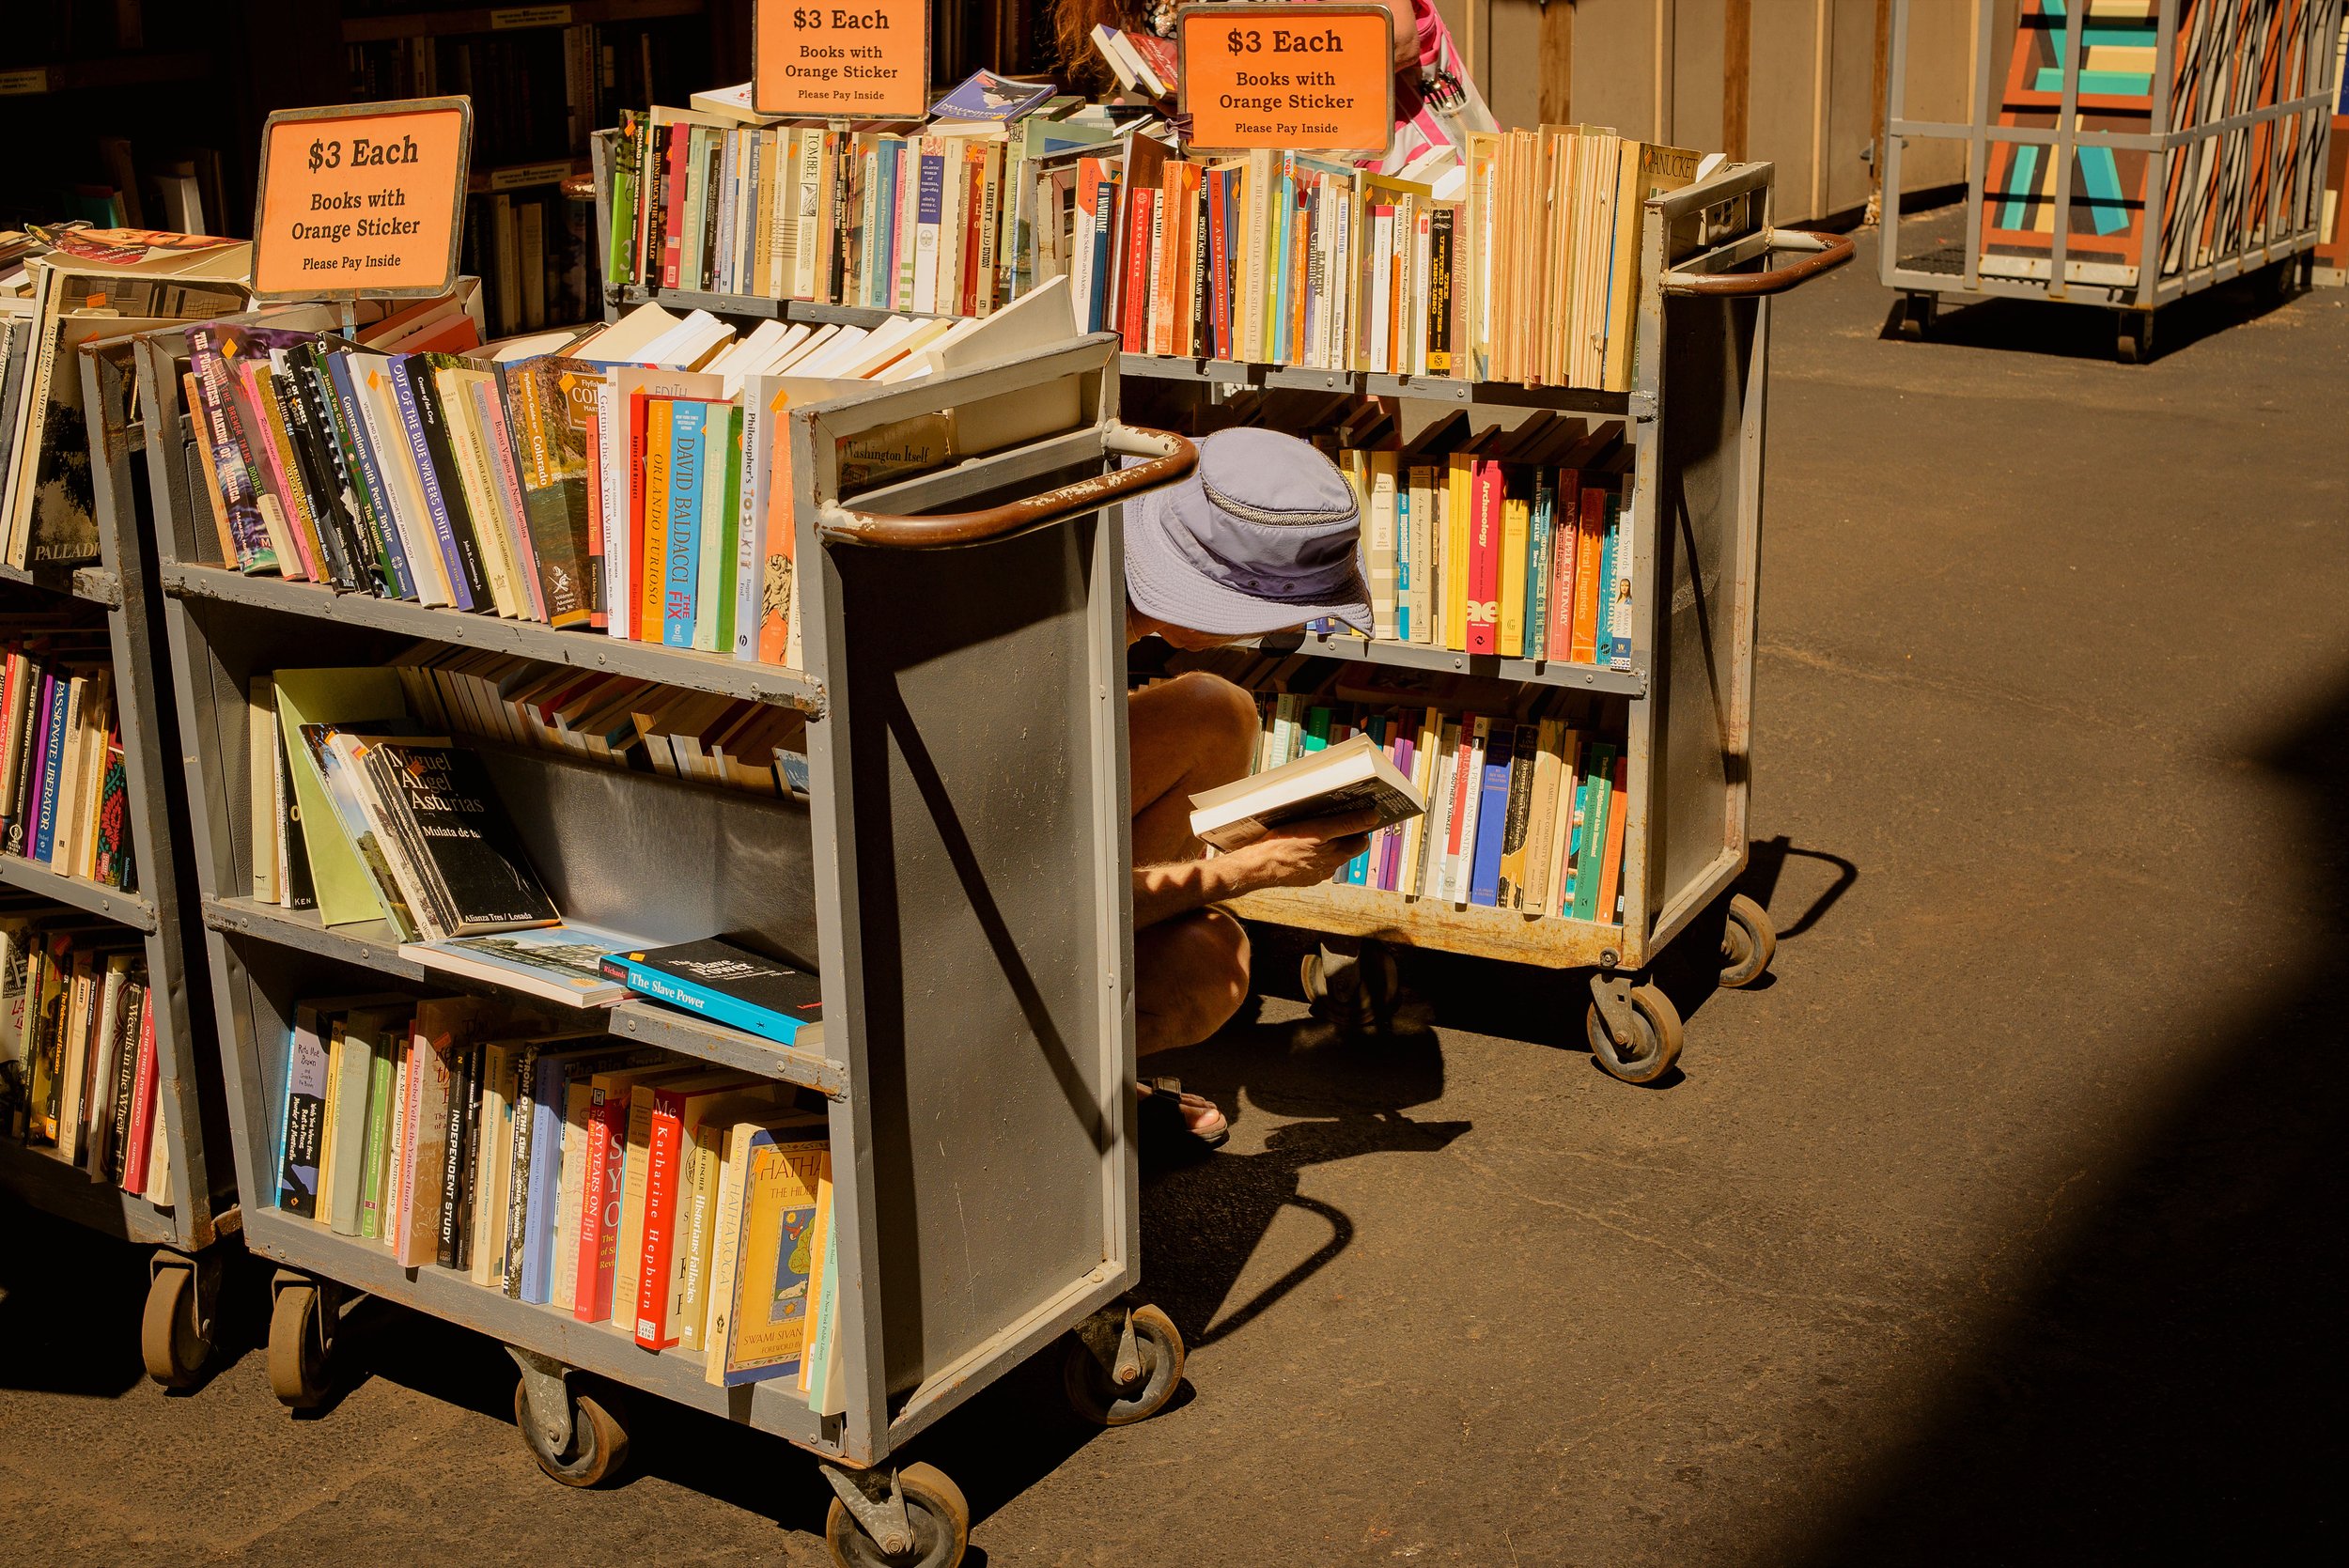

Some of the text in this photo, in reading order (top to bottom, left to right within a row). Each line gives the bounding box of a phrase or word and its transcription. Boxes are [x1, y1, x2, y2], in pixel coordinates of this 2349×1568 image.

[793, 8, 890, 32] $3 Each
[800, 45, 883, 58] Books with
[1227, 28, 1344, 56] $3 Each
[785, 65, 898, 82] Orange Sticker
[1236, 71, 1336, 86] Books with
[798, 89, 885, 101] Please Pay Inside
[1220, 94, 1354, 113] Orange Sticker
[634, 125, 644, 159] RICHARD
[1235, 123, 1339, 135] Please Pay Inside
[308, 134, 419, 174] $3 Each
[806, 133, 819, 178] TOMBEE
[310, 188, 405, 210] Books with
[1096, 196, 1109, 233] WARTIME
[291, 217, 420, 242] Orange Sticker
[649, 220, 658, 259] BUFFALO!
[981, 180, 994, 268] LIBERTY AND UNION
[303, 254, 401, 271] Please Pay Inside
[1307, 231, 1318, 285] Granuaile
[194, 331, 241, 503] THE PORTUGUESE MAKING OF AMERICA
[522, 372, 549, 486] Flyfisher's Guide Colorado
[220, 386, 263, 496] THE BREWER TWINS DOUBLE
[393, 364, 450, 541] OUT OF THE BLUE WRITERS UNITE
[745, 412, 756, 483] Philosopher's
[904, 444, 930, 463] Itself
[341, 395, 395, 543] Conversations with Peter Taylor
[494, 420, 506, 446] Betwixt
[500, 446, 512, 474] Virginia
[510, 488, 521, 509] North
[516, 510, 528, 538] Carolina
[598, 395, 614, 544] Getting the Sex You Want
[363, 503, 374, 520] The
[671, 437, 695, 584] DAVID BALDACCI
[1478, 480, 1490, 547] Archaeology
[368, 520, 384, 554] Founder
[648, 453, 663, 606] ORLANDO FURIOSO
[1399, 514, 1409, 562] Impeachment
[1622, 540, 1630, 569] Swords
[666, 591, 682, 620] FIX
[681, 594, 691, 619] THE
[1559, 570, 1570, 625] DICTIONARY
[1578, 570, 1590, 619] Linguistics
[23, 709, 34, 746] Modern
[39, 680, 65, 831] PASSIONATE LIBERATOR
[385, 748, 453, 773] Miguel
[1460, 753, 1470, 783] MEANS
[412, 790, 484, 813] Asturias
[1444, 771, 1456, 834] SOUTHERN YANKEES
[1468, 771, 1477, 801] PEOPLE
[422, 826, 470, 838] Mulata de
[1461, 830, 1470, 862] NATION
[465, 912, 533, 924] Alianza Losada
[603, 965, 627, 980] Richards
[630, 972, 649, 989] The
[652, 978, 675, 999] Slave
[677, 987, 705, 1009] Power
[115, 1003, 138, 1135] Weevils in the Wheat
[654, 1097, 677, 1120] Me
[405, 1148, 413, 1178] Yankee
[441, 1109, 459, 1243] INDEPENDENT STUDY
[589, 1109, 604, 1216] SIXTY YEARS ON
[403, 1180, 412, 1212] Hurrah
[718, 1136, 744, 1283] RADHA HATHA YOGA
[641, 1126, 667, 1308] Katharine Hepburn
[686, 1194, 705, 1303] Historians' Fallacies
